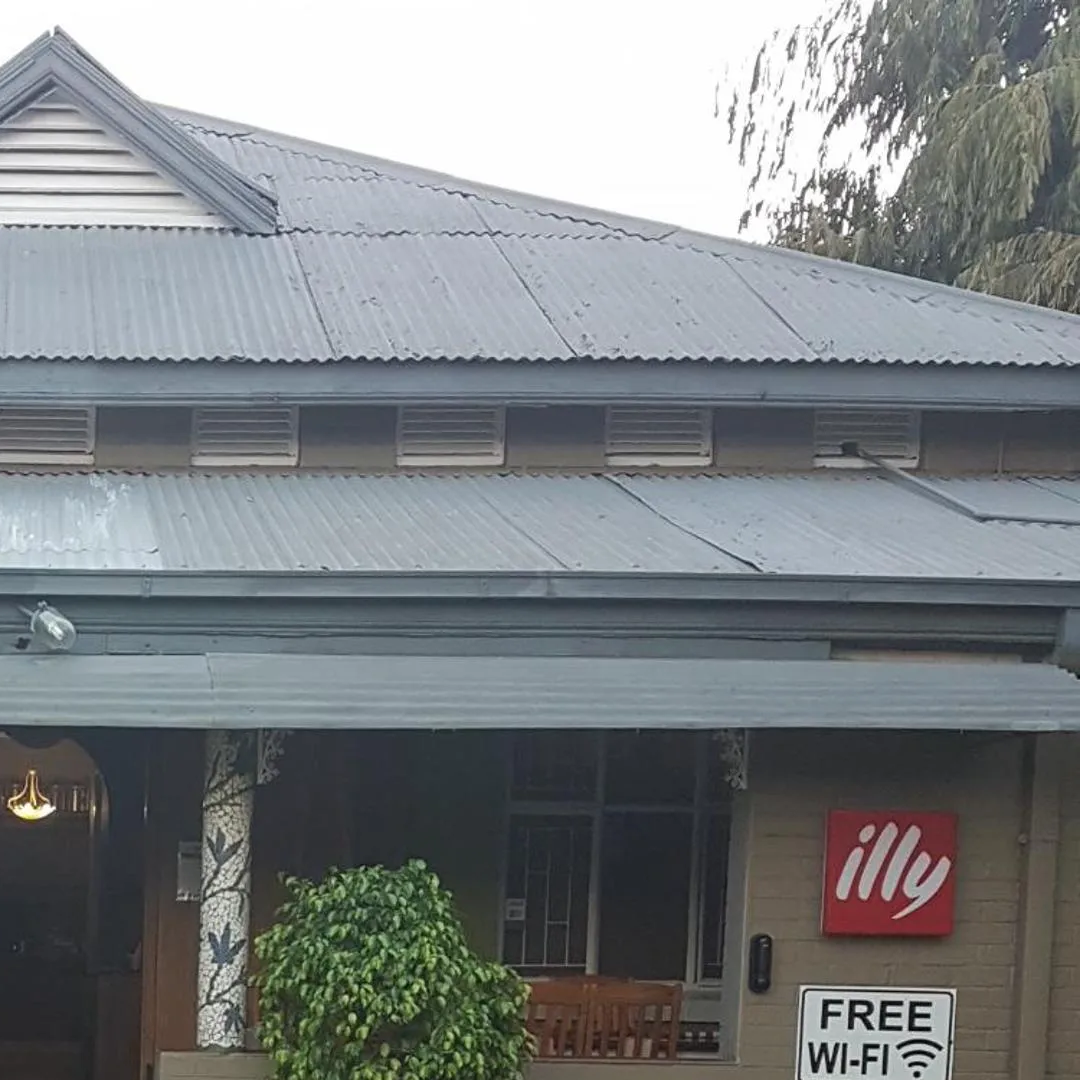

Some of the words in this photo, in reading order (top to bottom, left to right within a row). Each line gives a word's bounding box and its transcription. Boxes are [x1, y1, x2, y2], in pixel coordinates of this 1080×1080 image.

[836, 821, 951, 920] illy
[820, 999, 932, 1032] FREE
[808, 1042, 889, 1076] WI-FI
